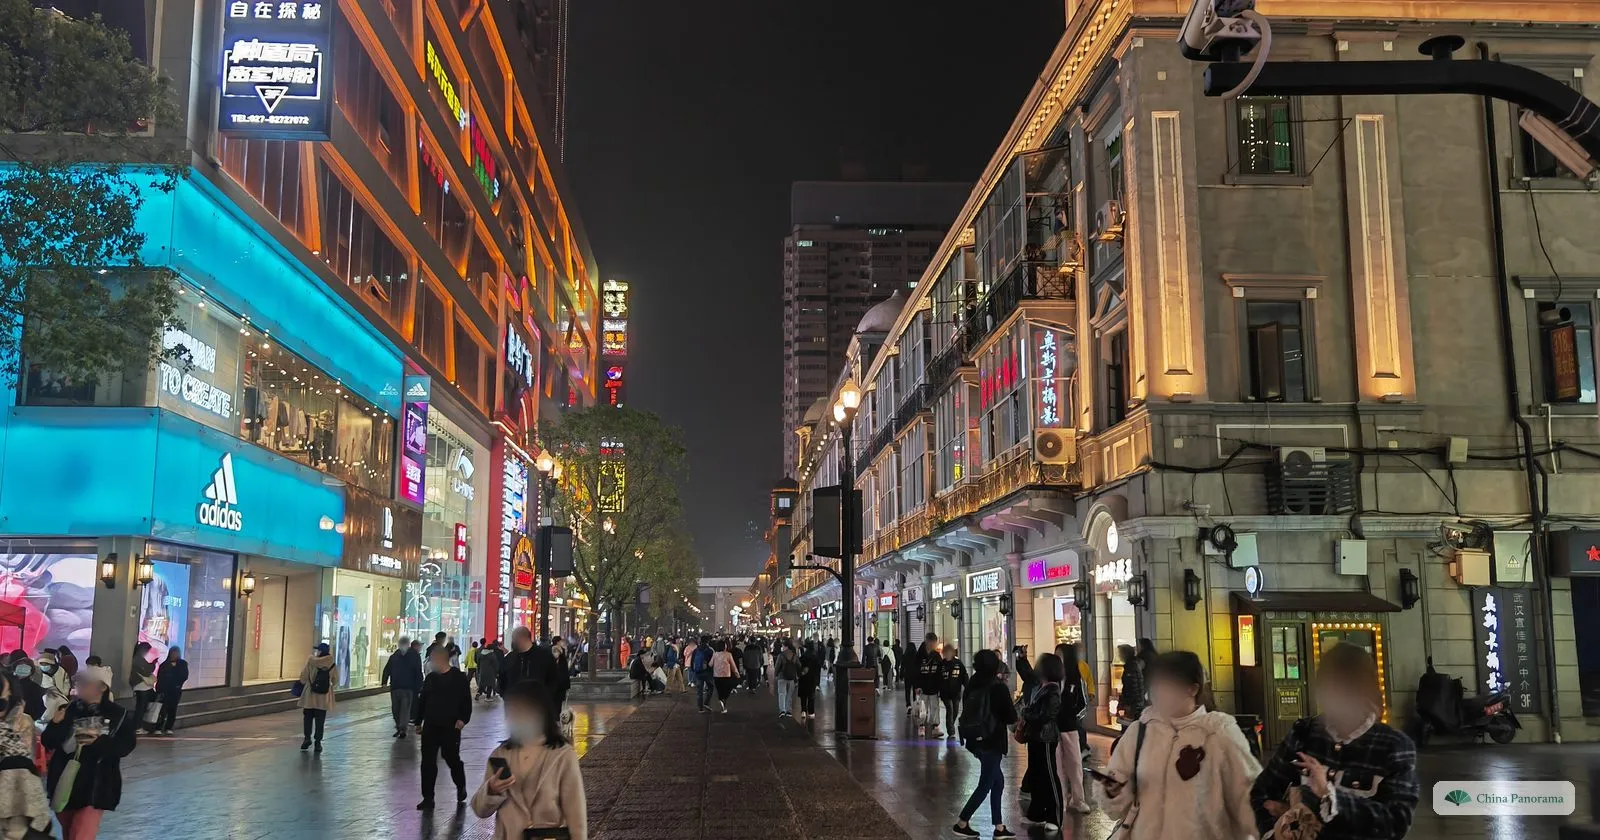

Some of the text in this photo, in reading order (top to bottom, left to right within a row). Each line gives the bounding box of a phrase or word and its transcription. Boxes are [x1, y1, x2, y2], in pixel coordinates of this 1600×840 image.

[230, 1, 321, 20] 自在探秘
[160, 362, 232, 419] TO CREATE
[198, 500, 243, 531] adidas
[1519, 693, 1532, 708] 3F
